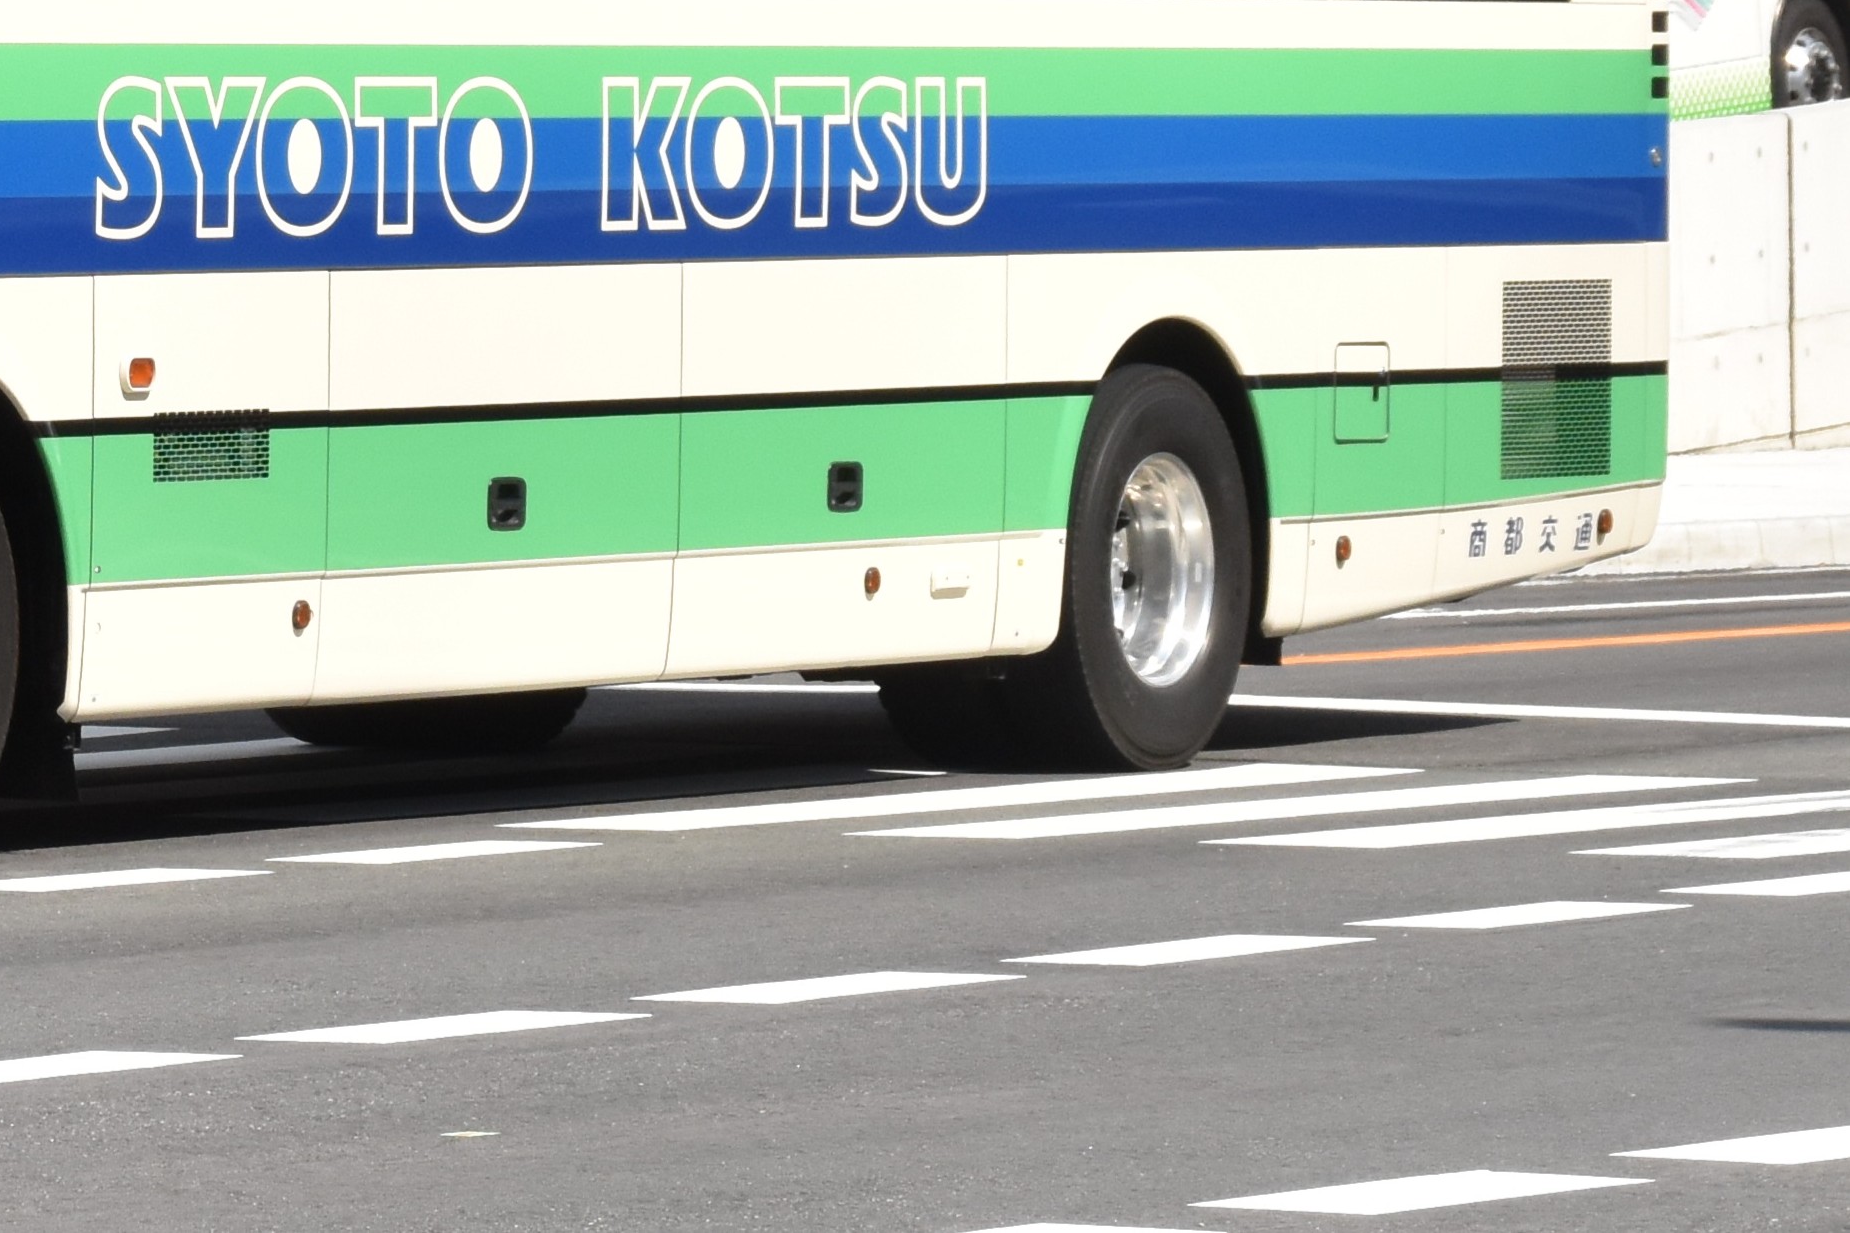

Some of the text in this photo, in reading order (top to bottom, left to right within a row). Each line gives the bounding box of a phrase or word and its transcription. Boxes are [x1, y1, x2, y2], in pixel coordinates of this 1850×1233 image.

[95, 75, 987, 240] SYOTO KOTSU
[1468, 513, 1593, 558] 商都交通
